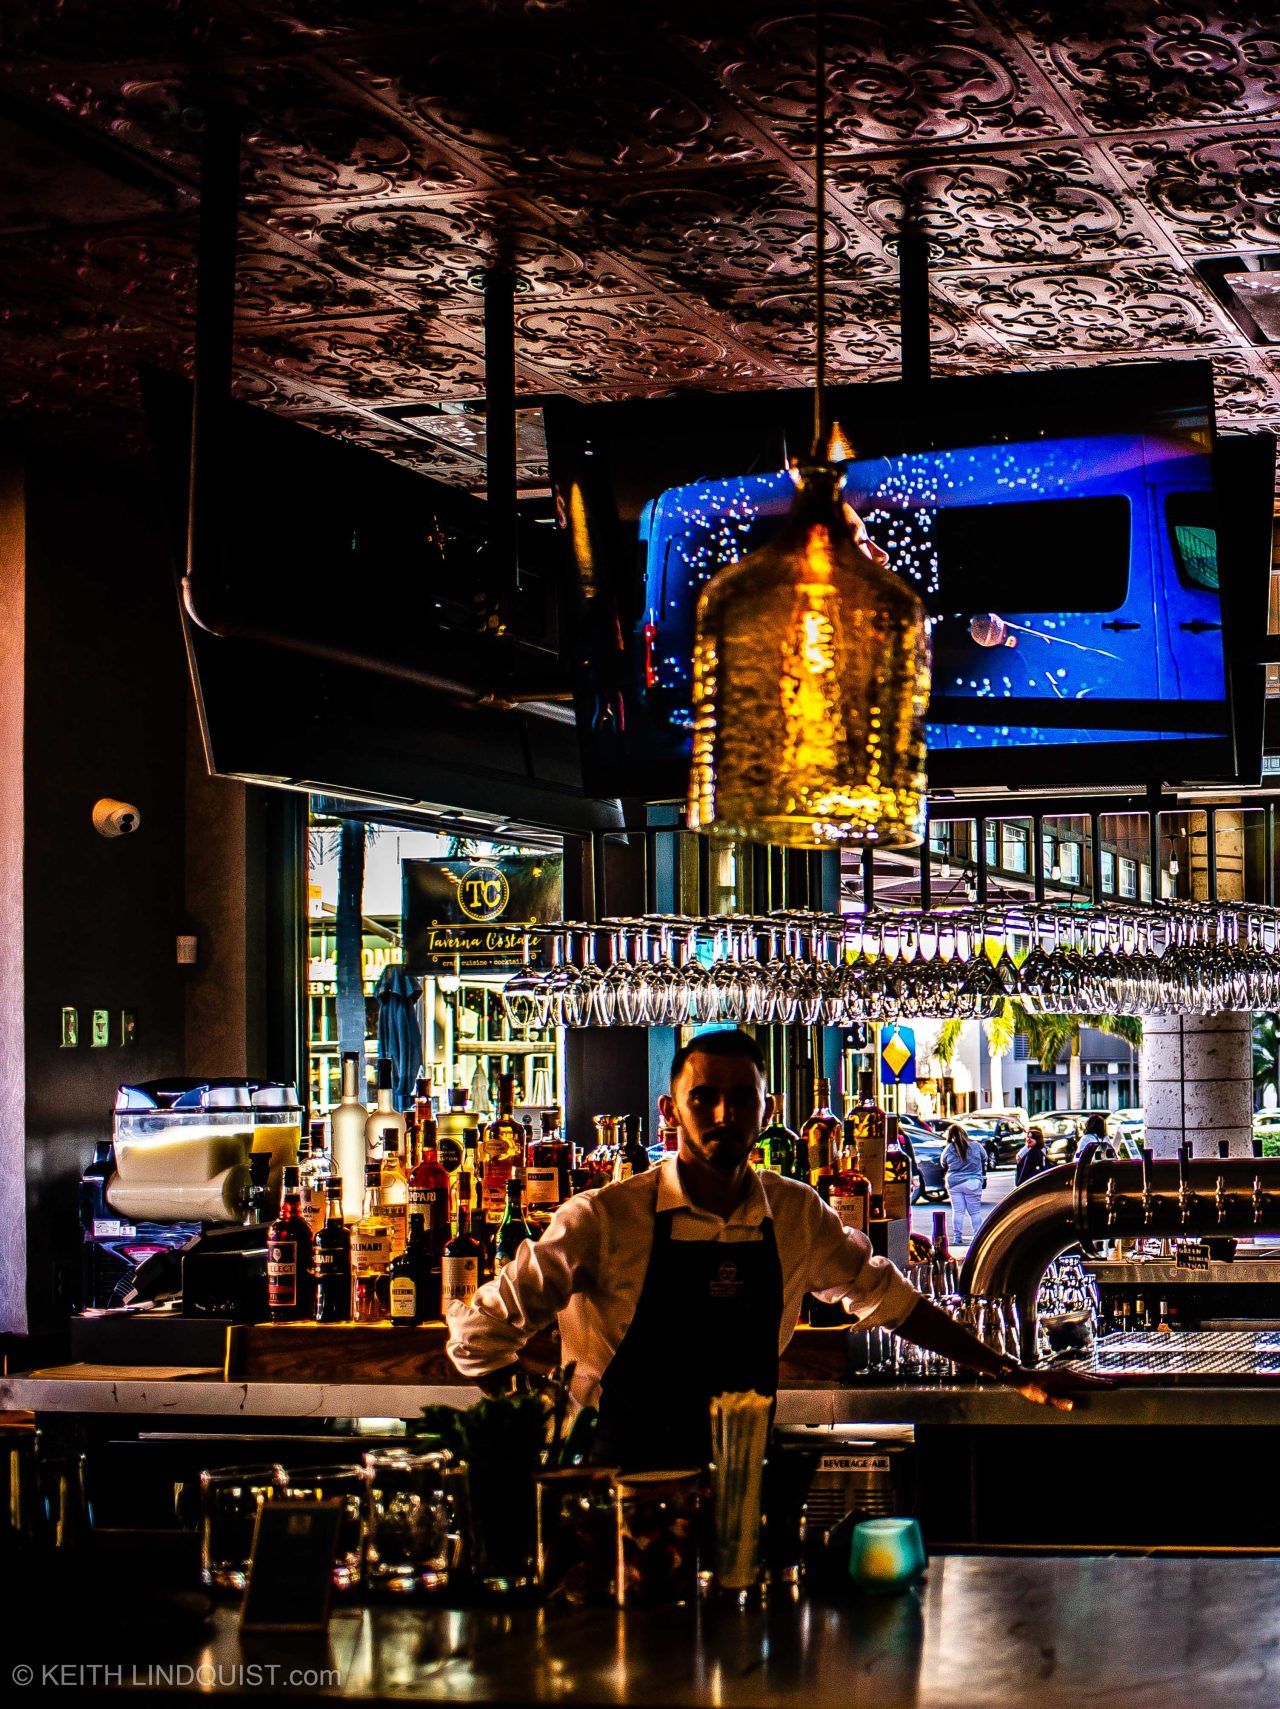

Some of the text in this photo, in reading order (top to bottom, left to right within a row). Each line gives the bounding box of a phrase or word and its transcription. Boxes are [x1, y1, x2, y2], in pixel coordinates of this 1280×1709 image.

[466, 880, 501, 908] TC
[428, 931, 542, 950] Taverna Costae
[442, 959, 459, 967] craf
[493, 957, 529, 965] cocktail
